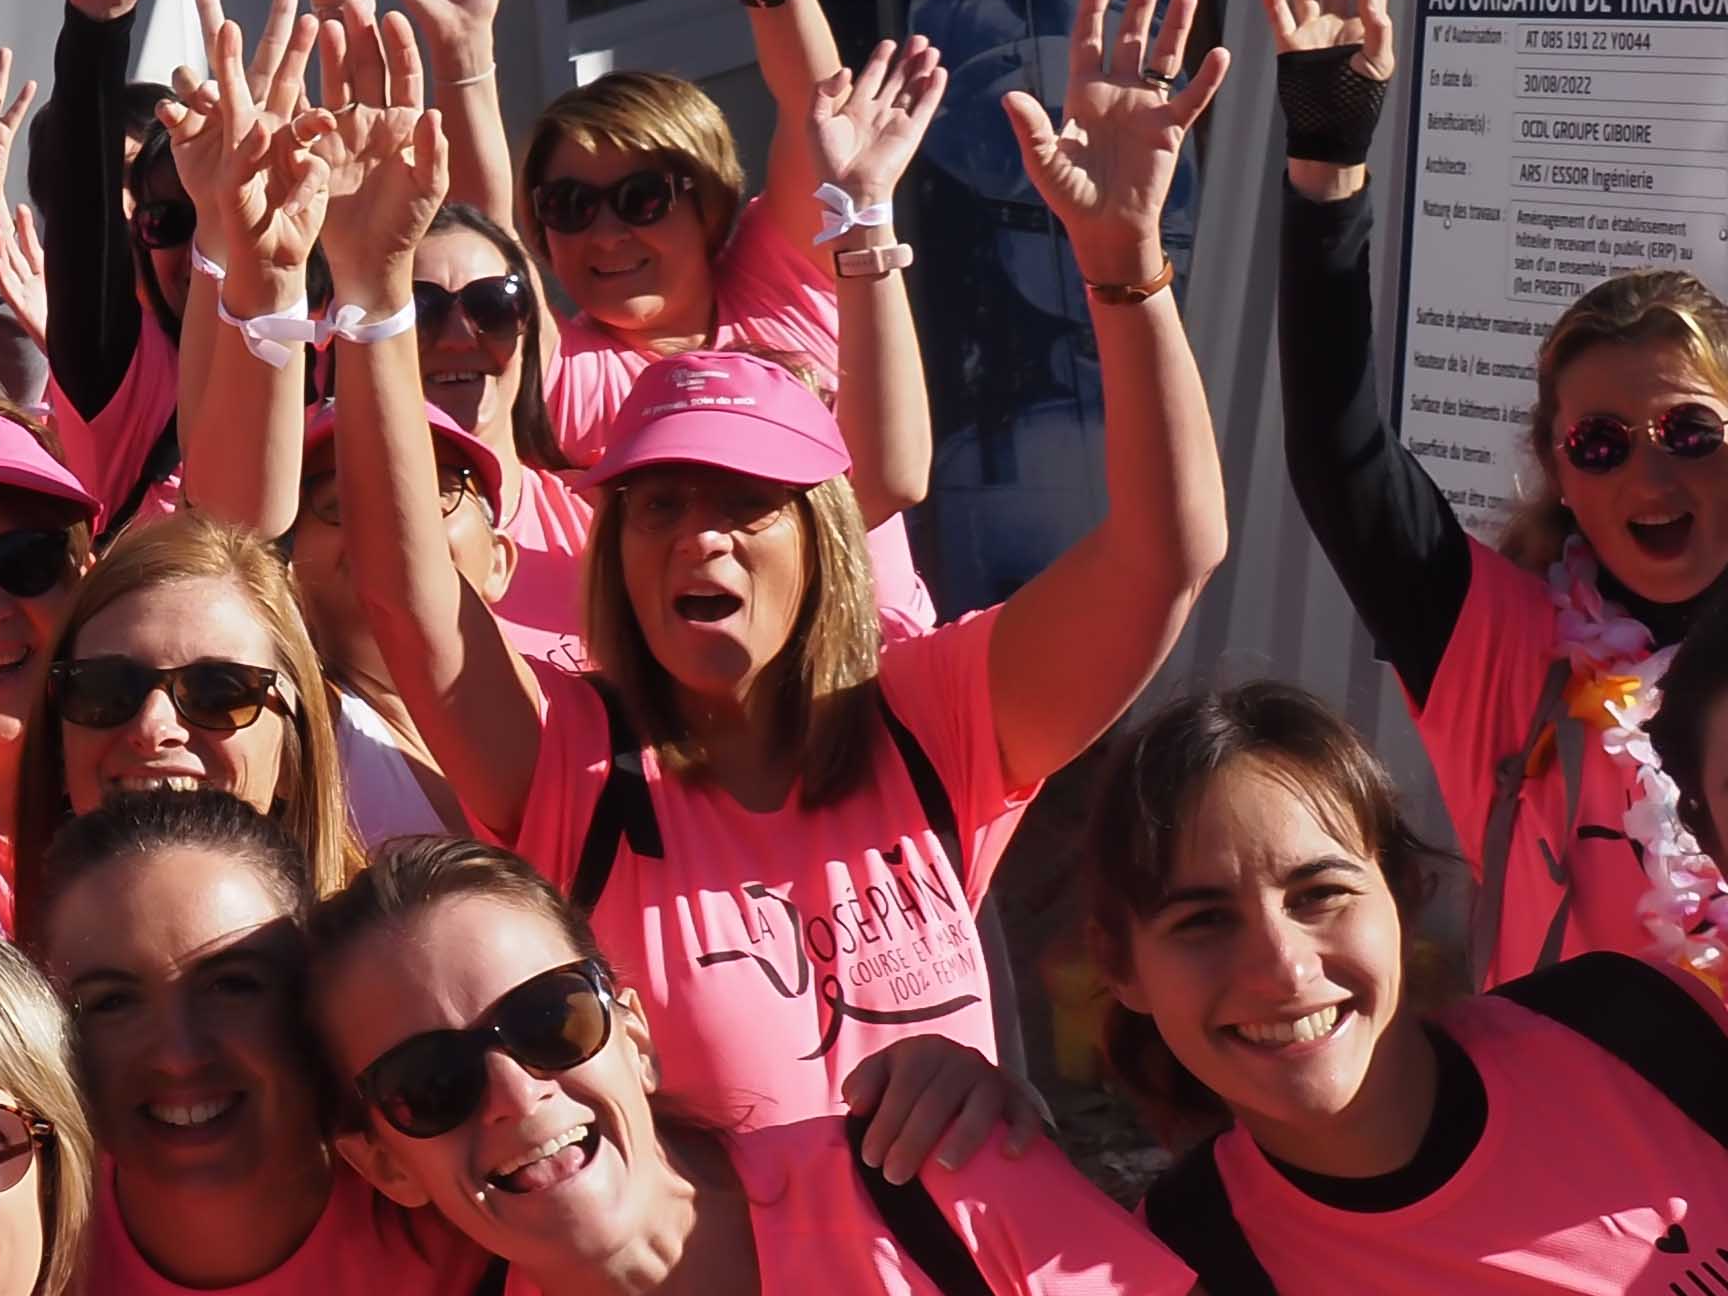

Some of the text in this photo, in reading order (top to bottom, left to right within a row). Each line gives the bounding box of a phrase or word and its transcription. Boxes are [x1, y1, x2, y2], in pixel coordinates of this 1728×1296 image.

[1526, 30, 1538, 47] AT
[1567, 31, 1588, 49] 191
[1592, 32, 1607, 50] 22
[1611, 33, 1651, 51] Y0044
[1523, 74, 1592, 94] 30/08/2022
[1522, 121, 1651, 143] OCDL GROUPE GIBOIRE
[1520, 164, 1542, 183] ARS
[1552, 166, 1589, 186] ESSOR
[1593, 168, 1654, 192] Ingénierie
[741, 906, 775, 945] LA
[849, 948, 911, 987] COURSE
[912, 937, 933, 962] ET
